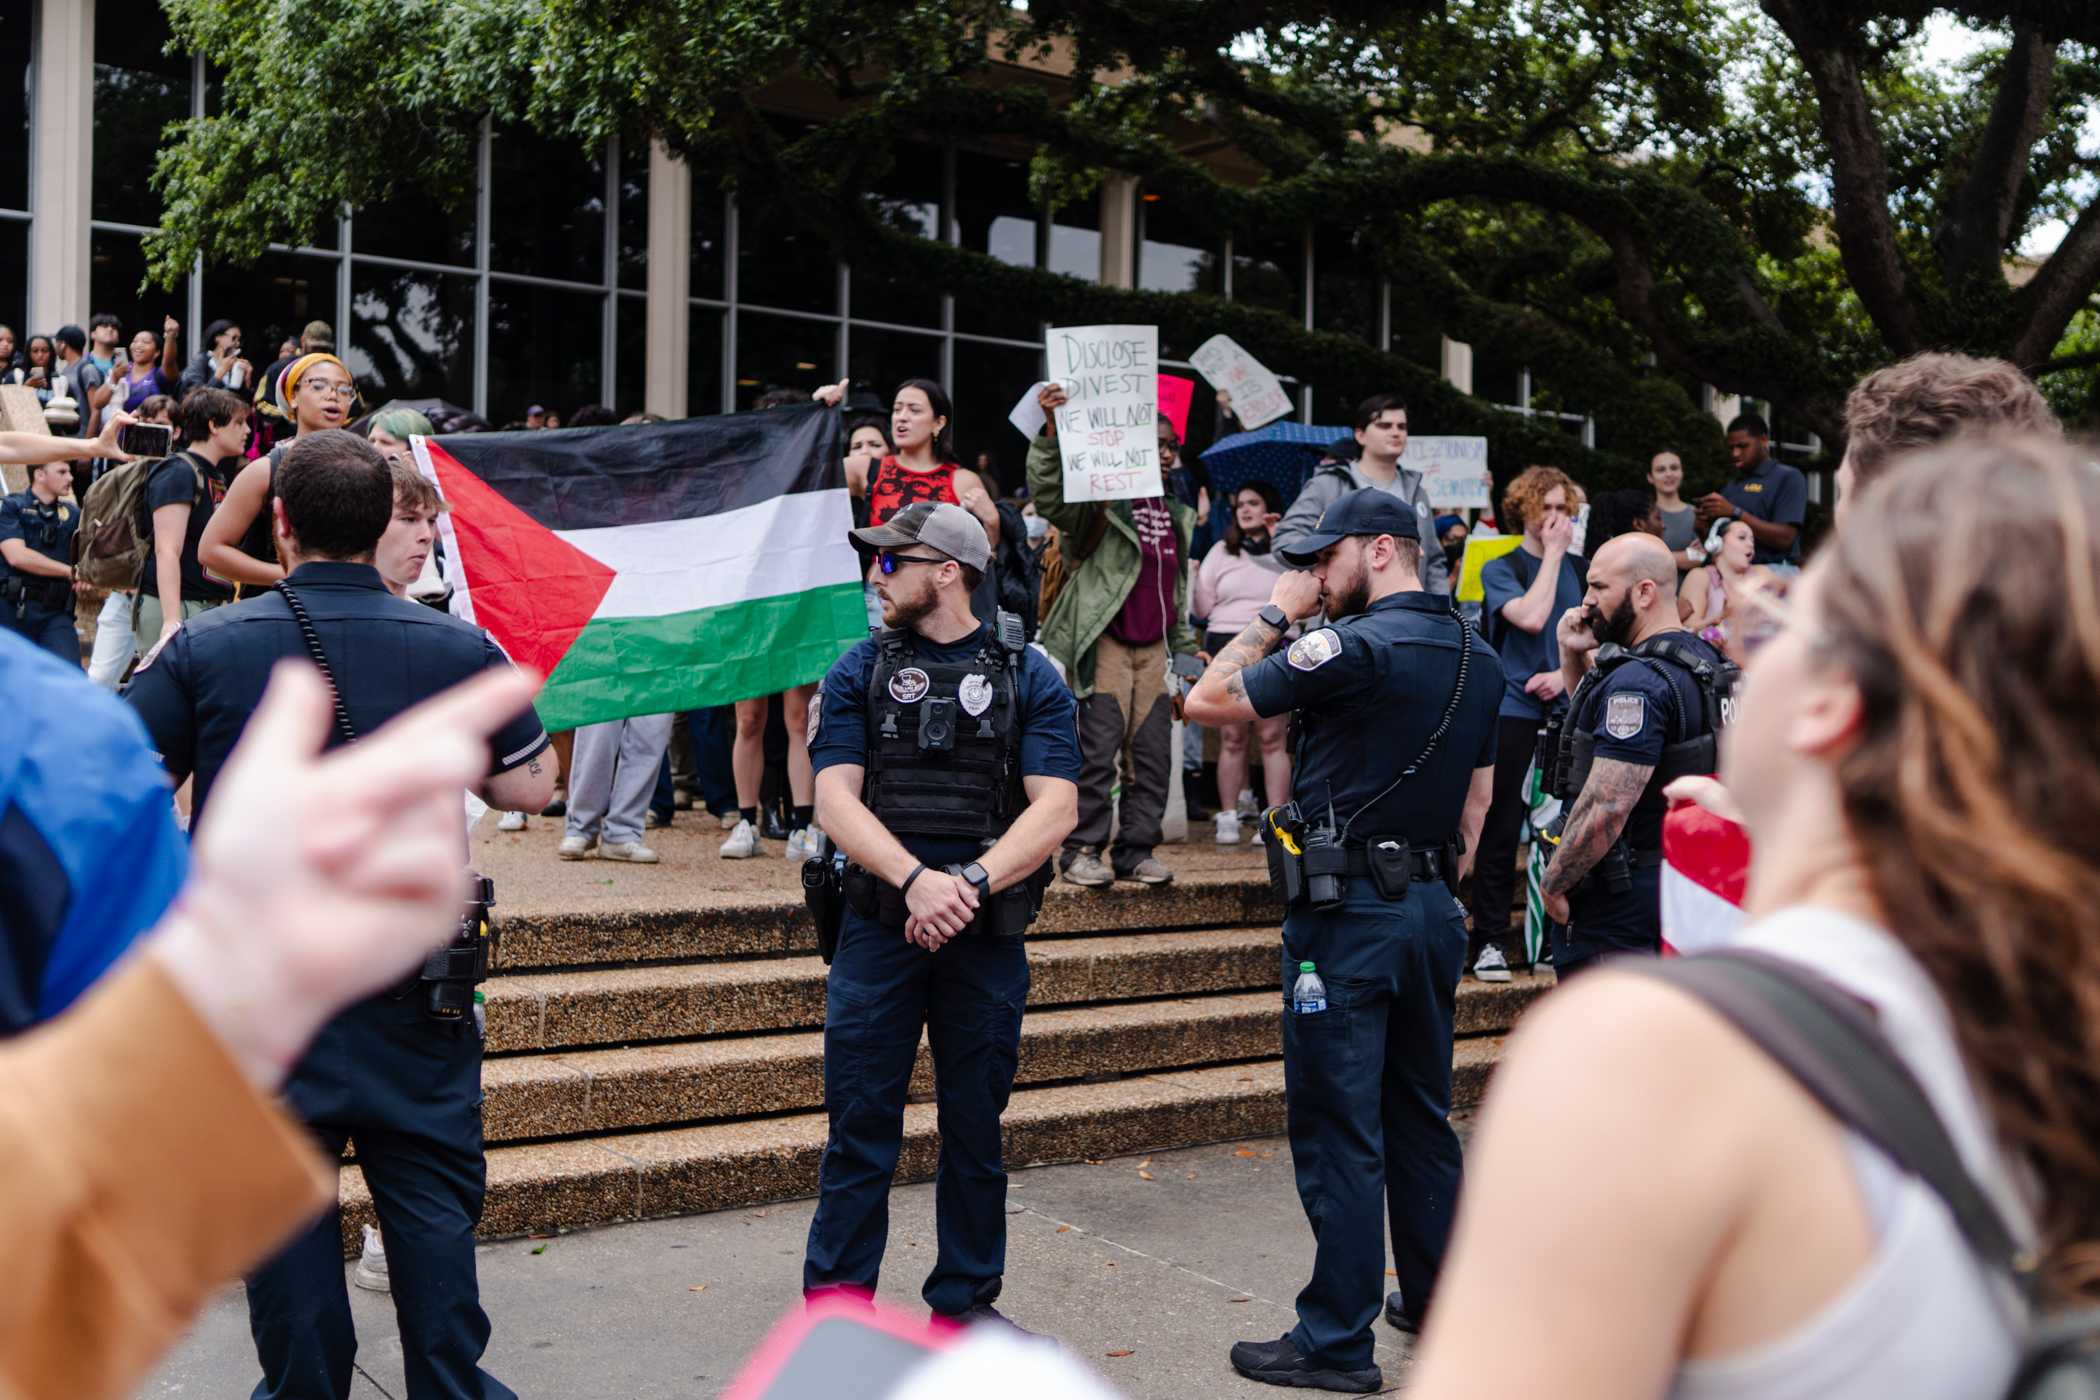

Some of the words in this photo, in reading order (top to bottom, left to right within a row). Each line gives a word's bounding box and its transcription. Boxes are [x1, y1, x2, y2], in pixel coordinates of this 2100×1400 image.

[1061, 334, 1149, 374] DISCLOSE
[1060, 373, 1149, 400] DIVEST
[1056, 409, 1082, 433] WE
[1087, 406, 1126, 429] WILL
[1127, 402, 1154, 427] NOT
[1088, 429, 1124, 448] STOP
[1067, 451, 1086, 472] WE
[1090, 450, 1122, 468] WILL
[1125, 447, 1152, 468] NOT
[1089, 470, 1143, 495] REST
[1613, 695, 1639, 705] POLICE
